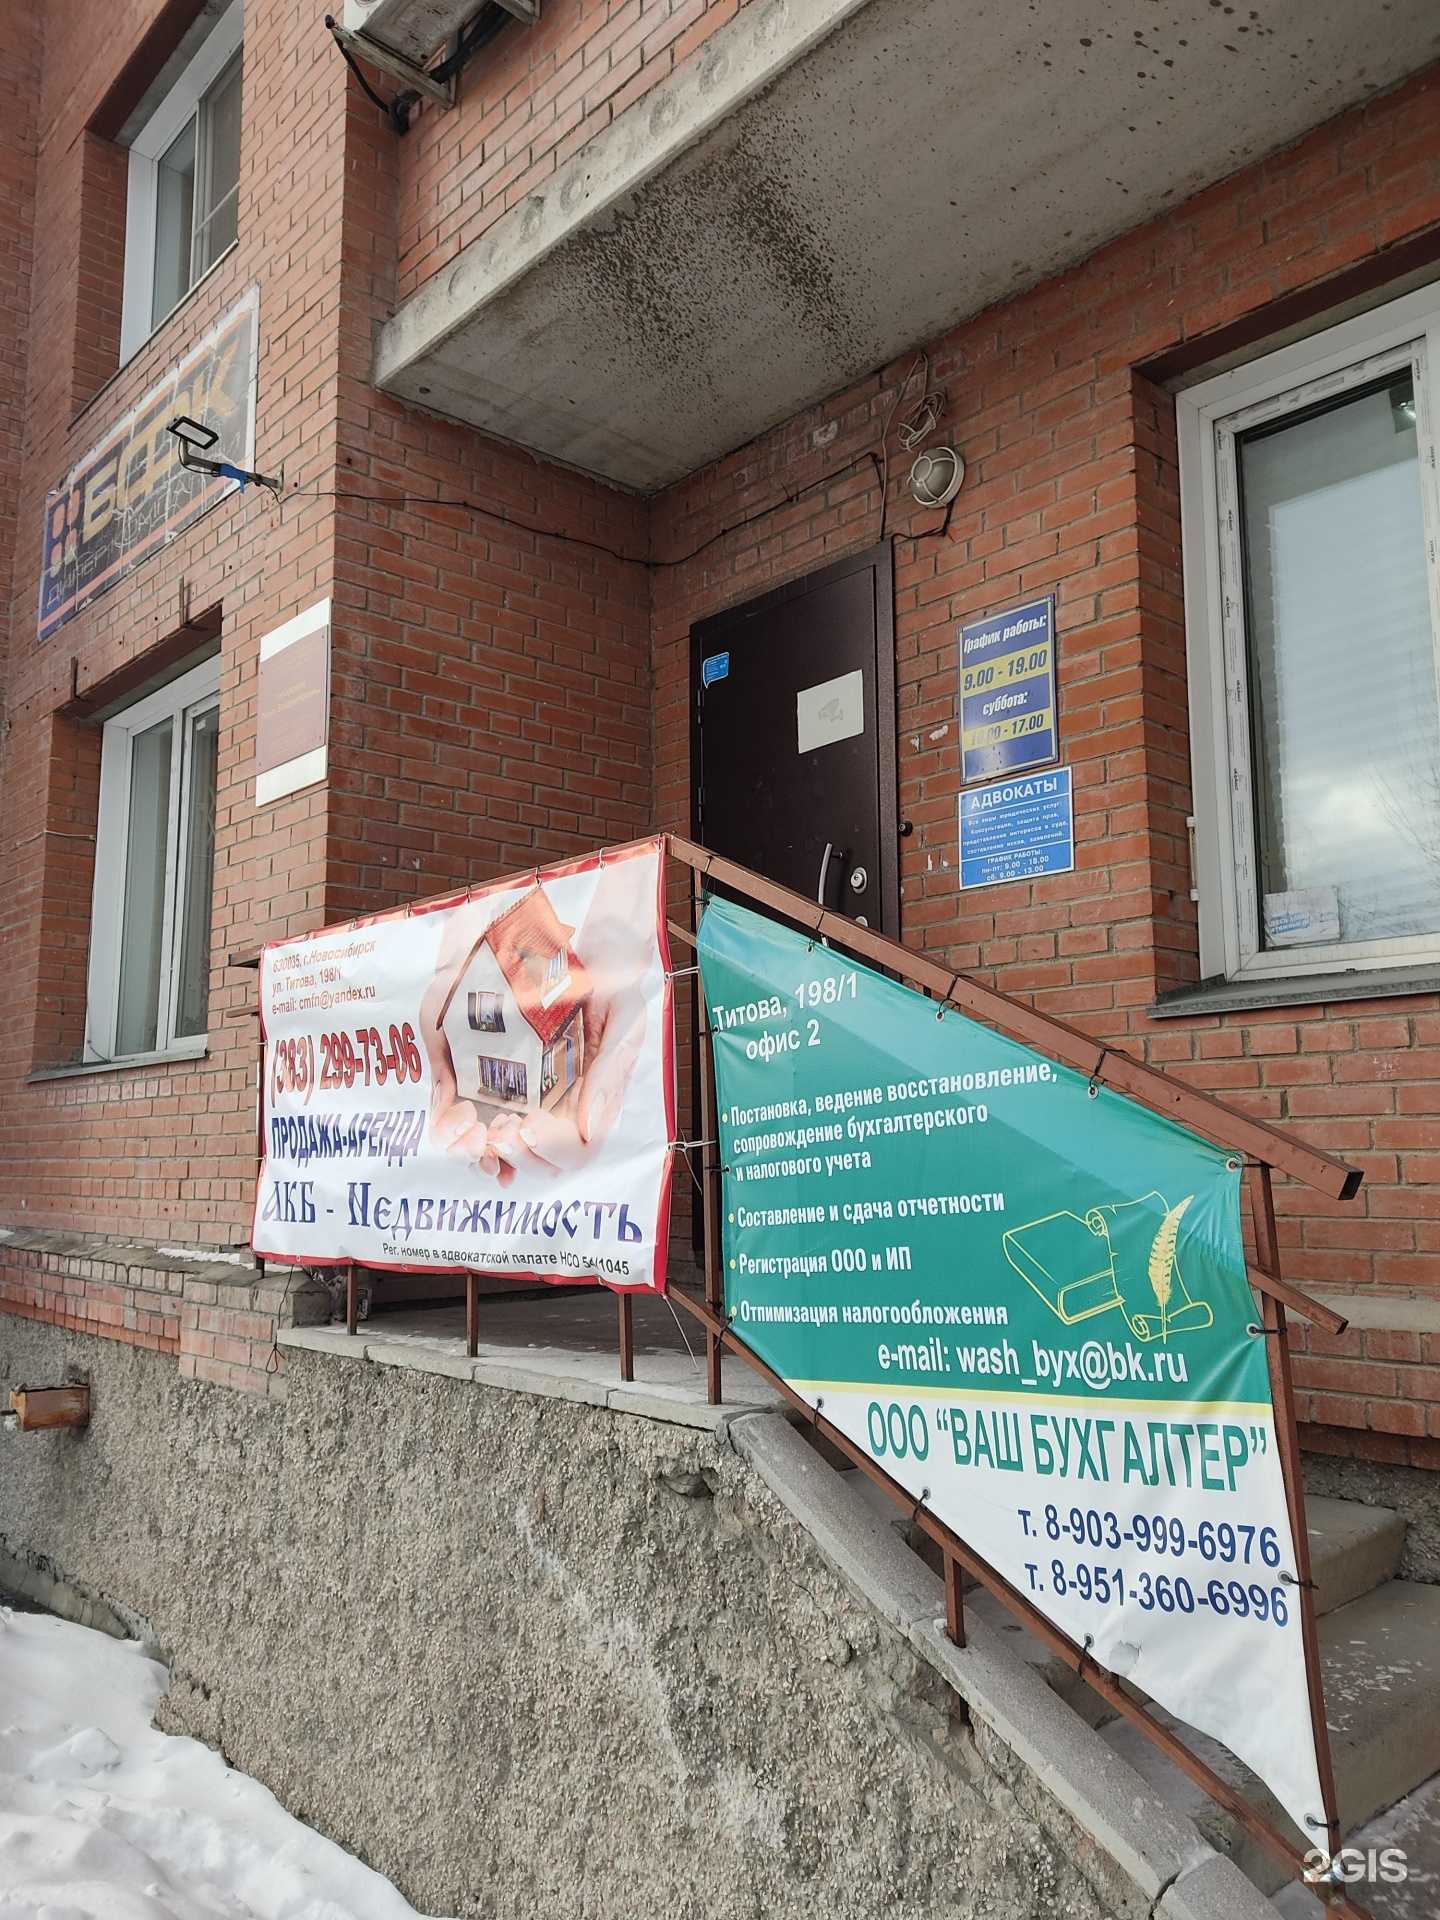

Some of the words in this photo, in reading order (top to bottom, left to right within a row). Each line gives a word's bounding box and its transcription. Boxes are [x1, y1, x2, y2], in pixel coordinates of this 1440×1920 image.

[964, 630, 1001, 654] График
[1003, 615, 1046, 642] работы:
[964, 666, 994, 690] 9.00
[1008, 650, 1047, 677] 19.00
[983, 692, 1028, 716] суббота:
[1012, 714, 1044, 734] 17.00
[972, 778, 1057, 809] АДВОКАТЫ
[303, 940, 376, 966] г.Новосибирск
[272, 982, 282, 997] ул.
[272, 998, 297, 1014] e-mail:
[712, 996, 788, 1031] Титова,
[794, 972, 857, 1010] 198/1
[746, 1028, 800, 1062] офис
[806, 1018, 821, 1046] 2
[271, 1034, 315, 1108] (383)
[319, 1022, 423, 1090] 299-73-06
[731, 1098, 812, 1126] Постановка,
[816, 1087, 883, 1114] ведение
[887, 1062, 1058, 1102] восстановление,
[272, 1110, 426, 1168] ПРОДАЖА-АРЕНДА
[734, 1123, 843, 1157] сопровождение
[848, 1104, 988, 1142] бухгалтерского
[736, 1167, 744, 1182] и
[746, 1156, 822, 1182] налогового
[825, 1150, 872, 1177] учета
[262, 1180, 316, 1224] АКБ
[738, 1205, 825, 1228] Составление
[829, 1204, 838, 1222] и
[843, 1200, 893, 1224] сдача
[898, 1192, 1005, 1218] отчетности
[383, 1243, 399, 1256] Рег.
[401, 1248, 430, 1261] номер
[433, 1250, 440, 1258] в
[442, 1250, 510, 1264] адвокатской
[512, 1252, 558, 1266] палате
[560, 1251, 580, 1268] НСО
[583, 1256, 630, 1276] 54/1045
[739, 1253, 828, 1279] Регистрация
[831, 1248, 867, 1272] ООО
[872, 1255, 882, 1271] и
[886, 1246, 912, 1270] ИП
[843, 1299, 1008, 1325] налогообложения
[878, 1336, 952, 1373] e-mail:
[956, 1338, 1188, 1390] wash_byx@bk.ru
[867, 1401, 930, 1462] ООО
[1018, 1508, 1038, 1538] т.
[1044, 1504, 1281, 1568] 8-903-999-6976
[1024, 1562, 1044, 1592] т.
[1052, 1559, 1289, 1628] 8-951-360-6996
